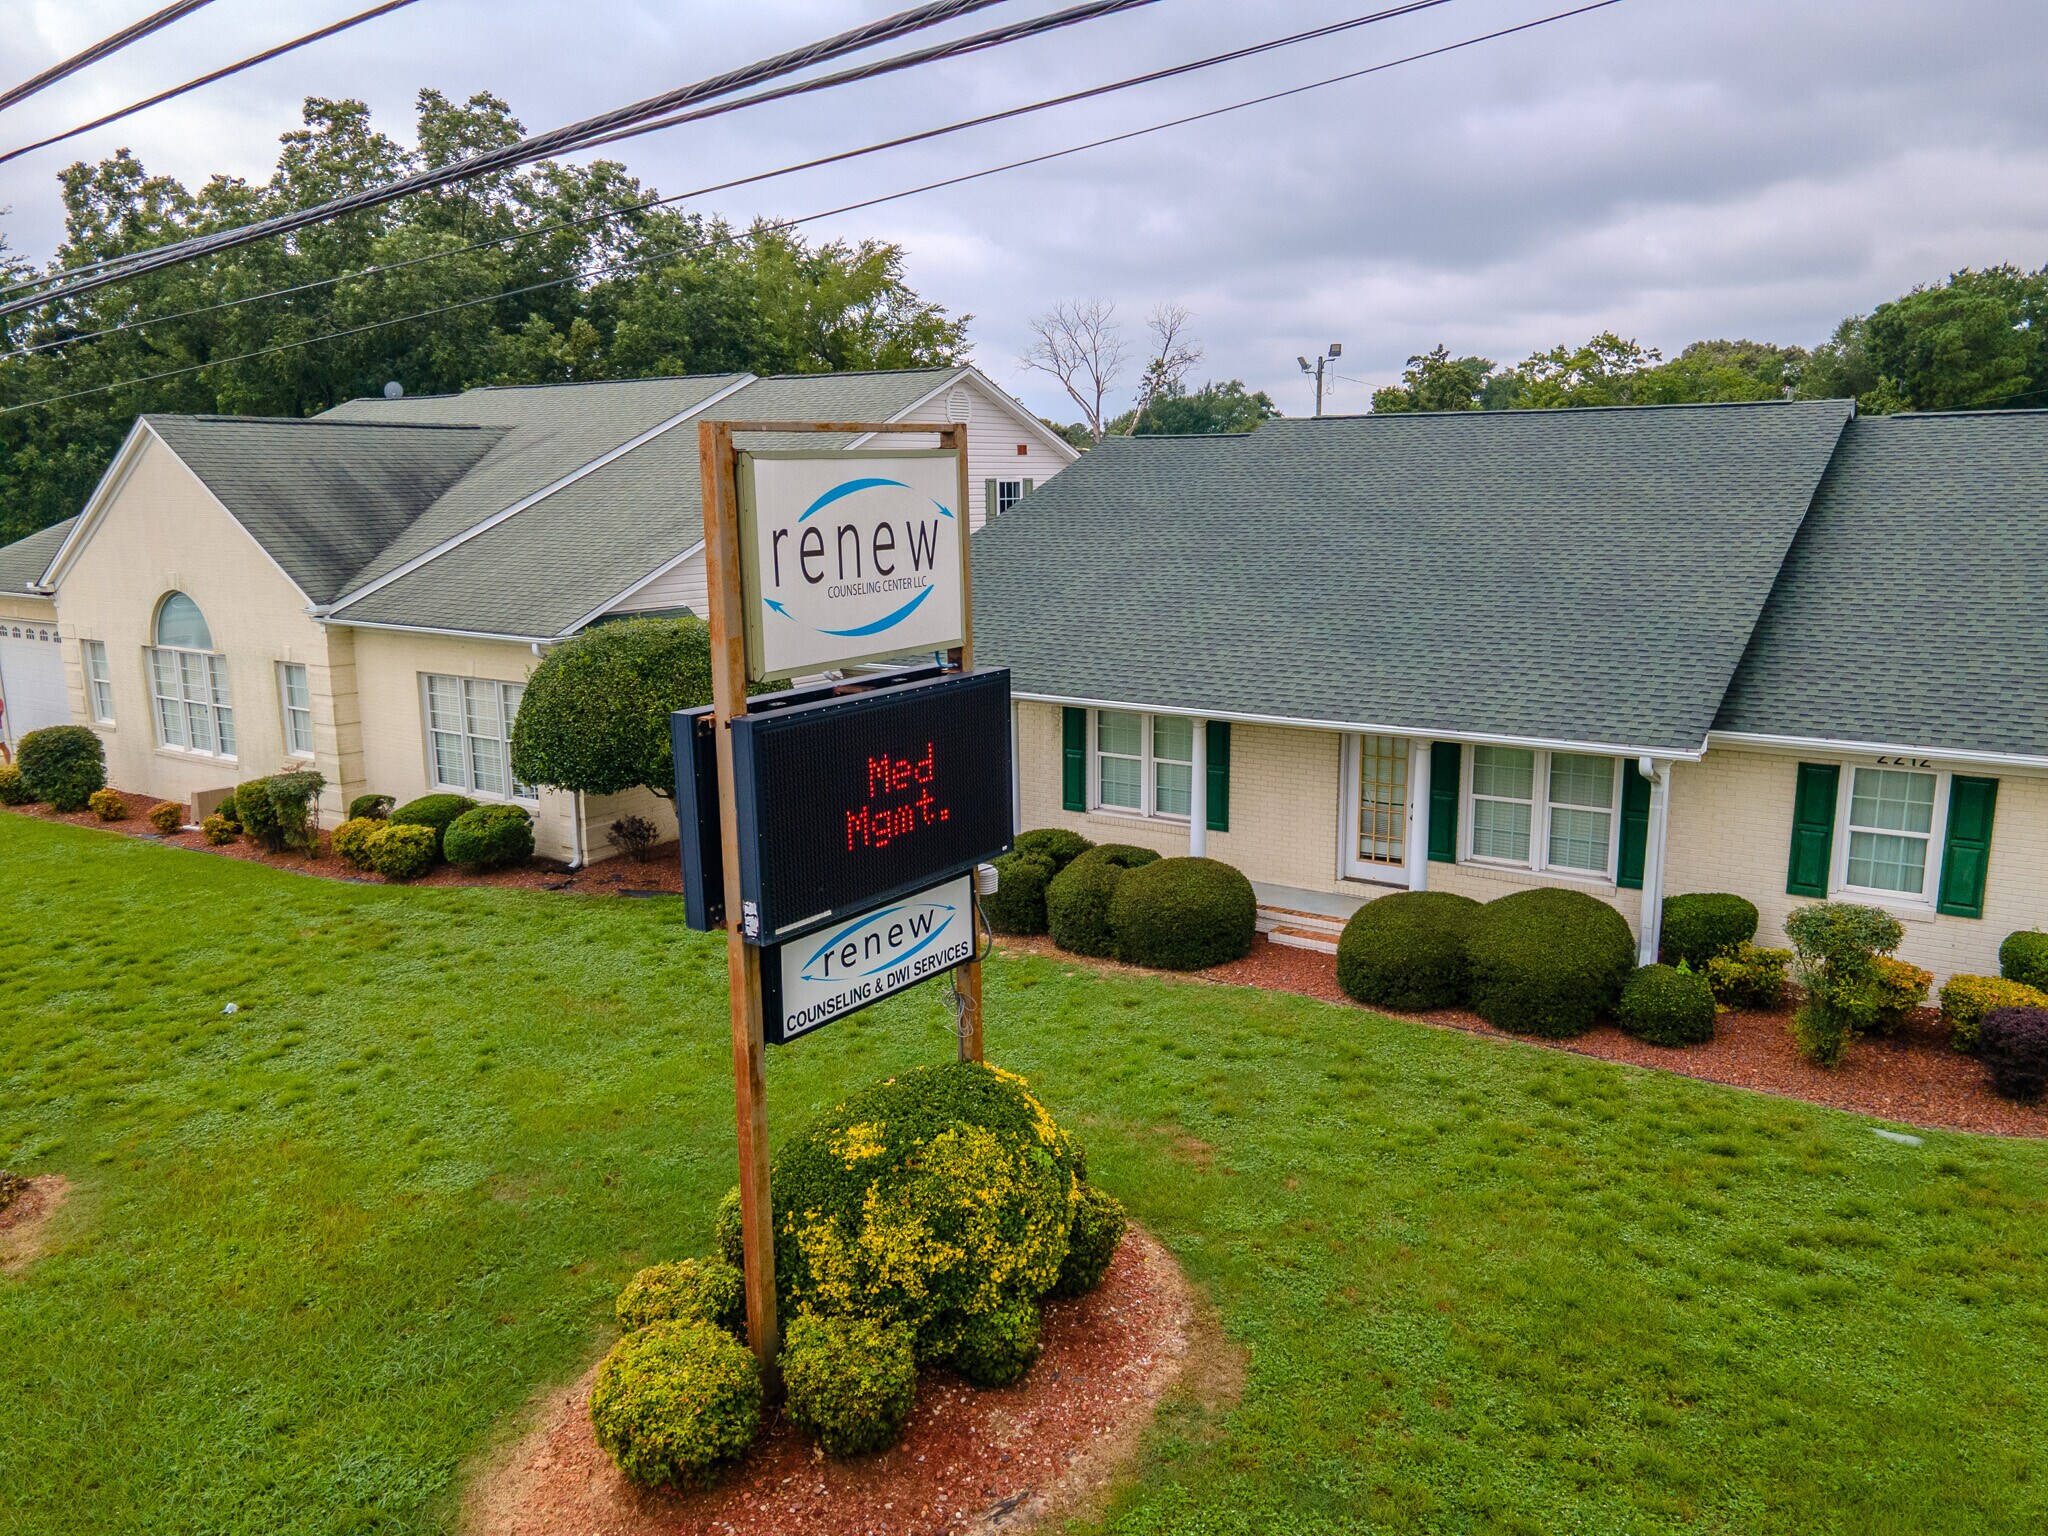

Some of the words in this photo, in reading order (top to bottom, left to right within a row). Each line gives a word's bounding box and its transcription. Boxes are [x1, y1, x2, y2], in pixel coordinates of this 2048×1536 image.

[772, 519, 938, 587] renew
[827, 581, 881, 598] COUNSELING
[882, 577, 912, 592] CENTER
[913, 575, 927, 588] LLC
[868, 741, 934, 798] Med
[846, 788, 950, 851] Mgmt.
[823, 909, 935, 977] renew
[786, 981, 872, 1032] COUNSELING
[874, 977, 884, 993] &
[887, 965, 910, 988] DWI
[913, 941, 969, 976] SERVICES
